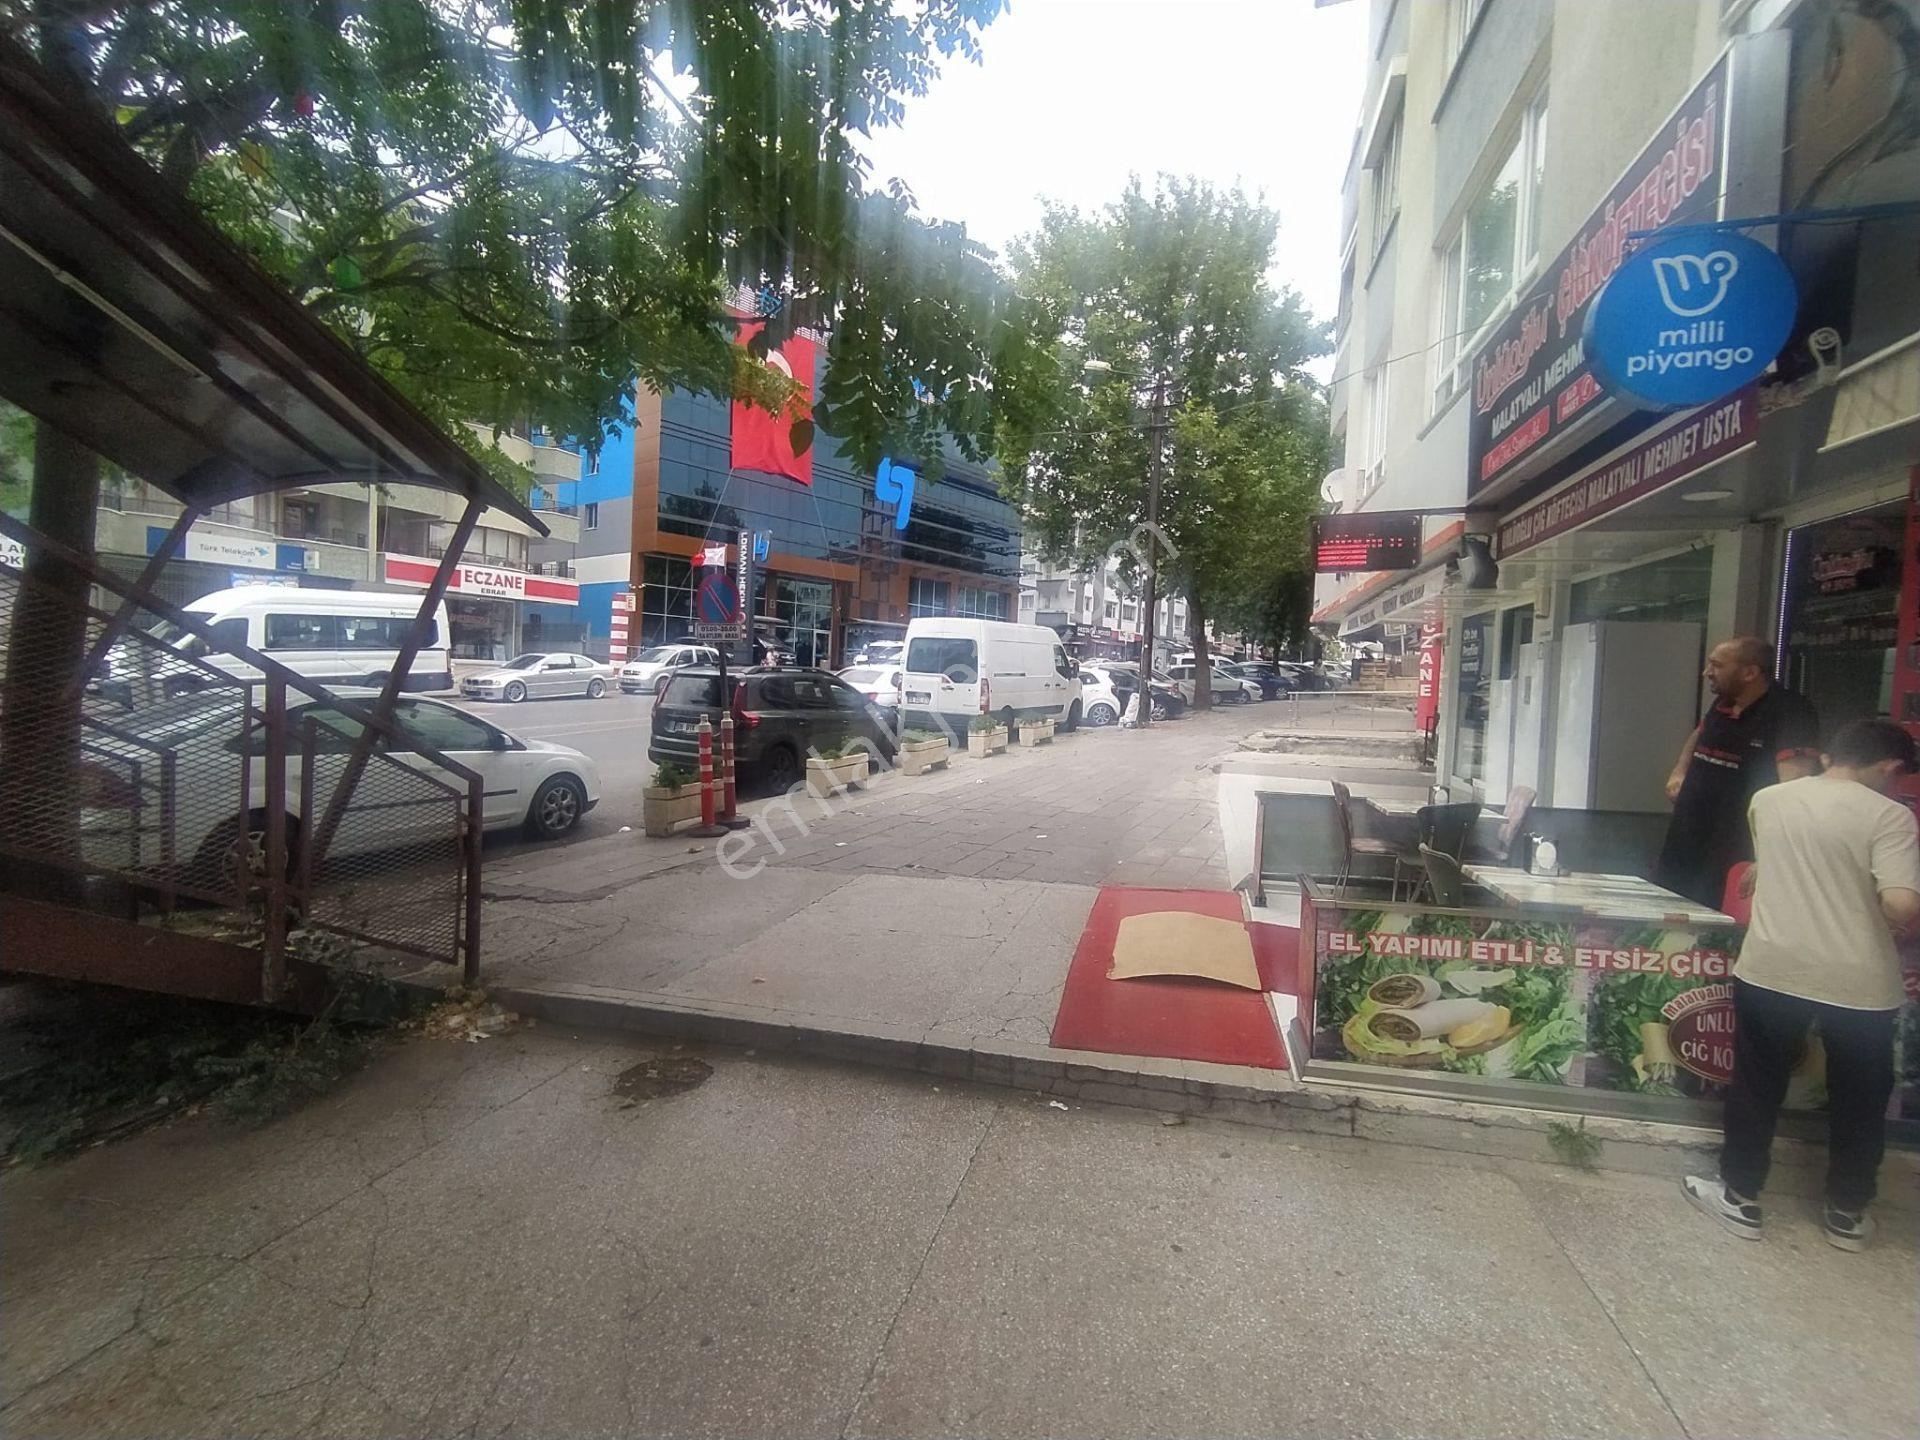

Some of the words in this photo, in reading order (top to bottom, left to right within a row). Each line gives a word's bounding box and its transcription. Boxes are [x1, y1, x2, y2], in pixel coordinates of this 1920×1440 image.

[1659, 321, 1725, 347] milli
[1627, 346, 1754, 377] piyango
[1492, 375, 1542, 440] MALATYALI
[1588, 455, 1642, 508] MALATYALI
[1643, 422, 1701, 481] MEHMET
[1702, 400, 1743, 450] USTA
[200, 543, 218, 552] Türk
[221, 546, 256, 557] Telekom
[740, 532, 749, 574] LOKMAN
[464, 569, 523, 590] ECZANE
[1330, 933, 1361, 951] EL
[1369, 935, 1462, 958] YAPIMI
[1471, 940, 1533, 963] ETLİ
[1543, 947, 1564, 965] &
[1575, 948, 1663, 972] ETSİZ
[1681, 1039, 1709, 1061] ÇİĞ
